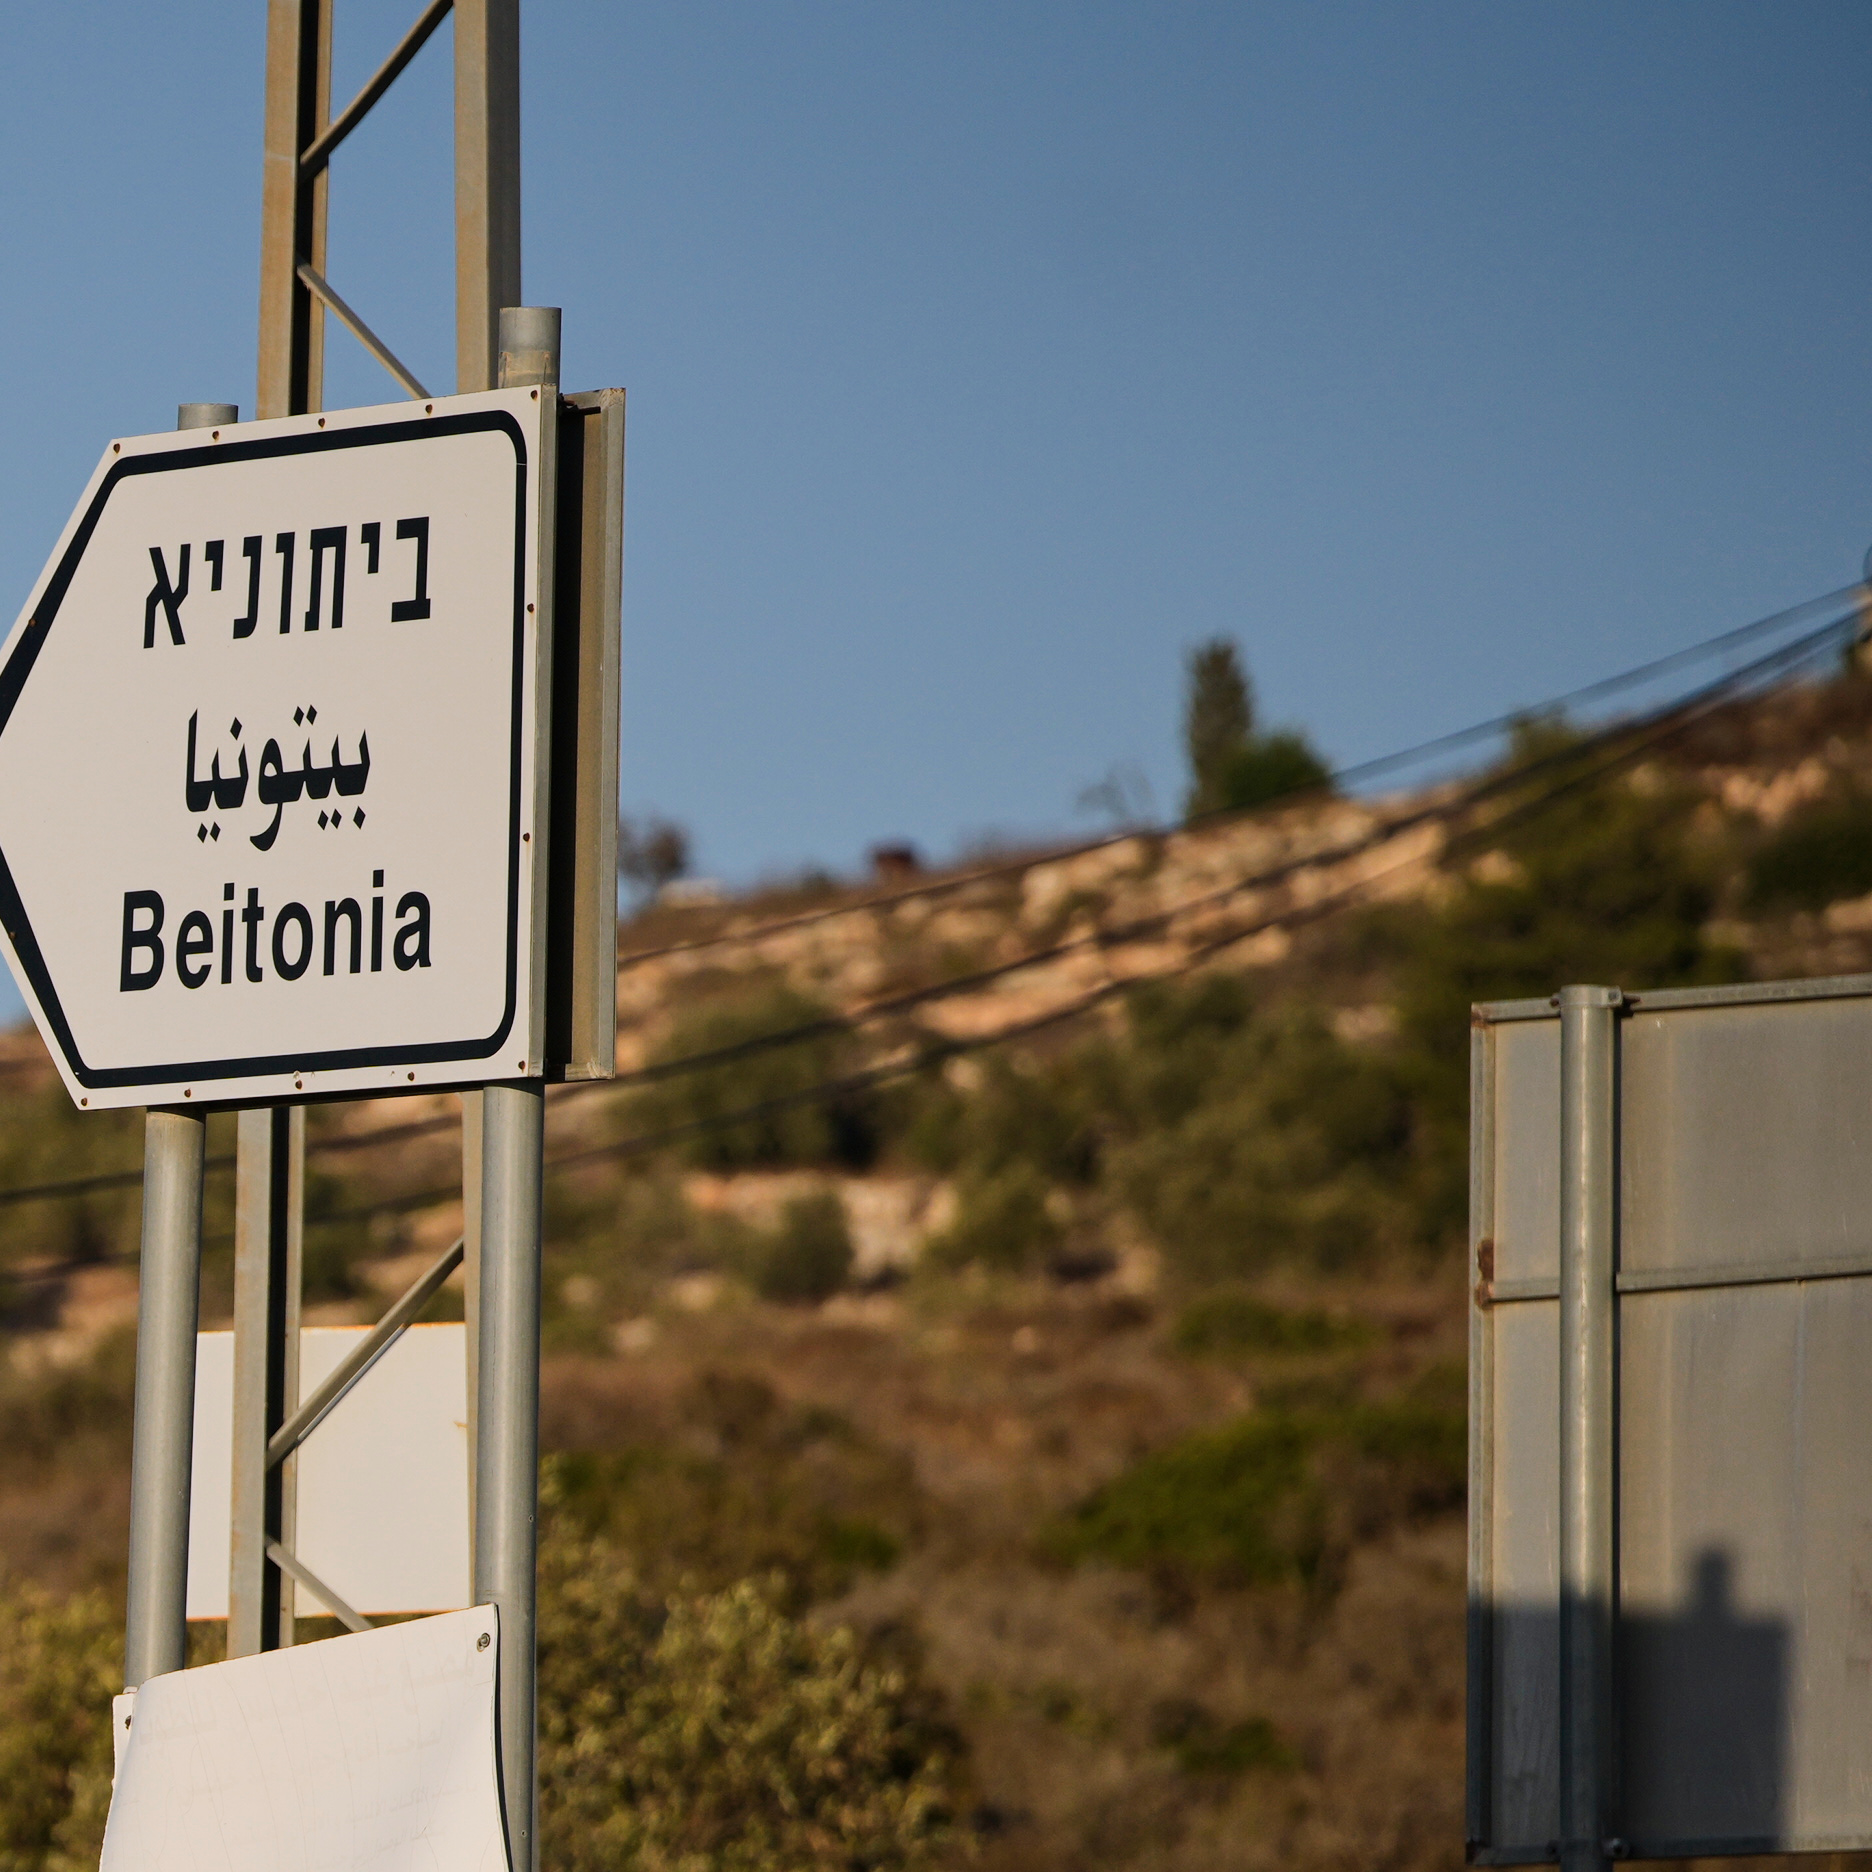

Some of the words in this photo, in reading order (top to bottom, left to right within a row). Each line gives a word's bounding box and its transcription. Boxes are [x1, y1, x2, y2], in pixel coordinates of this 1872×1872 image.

[143, 516, 431, 649] ביתוניא
[186, 704, 371, 852] بيتونيا
[119, 869, 432, 993] Beitonia
